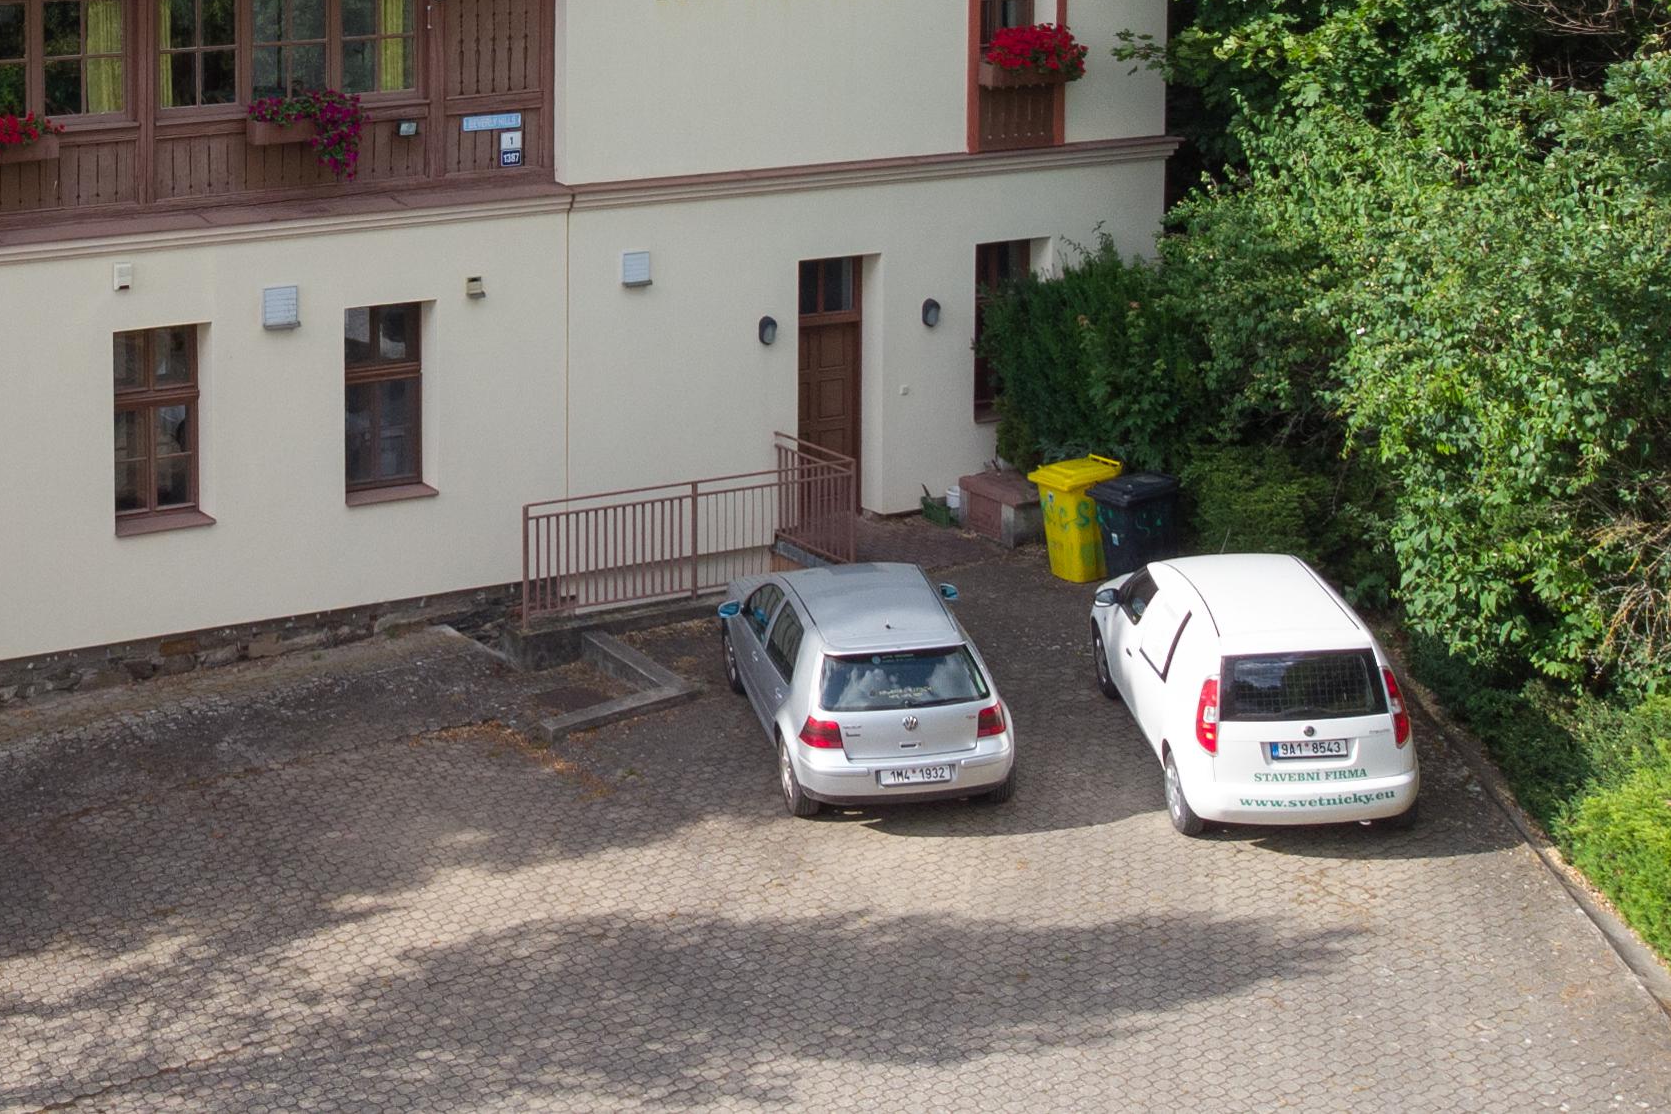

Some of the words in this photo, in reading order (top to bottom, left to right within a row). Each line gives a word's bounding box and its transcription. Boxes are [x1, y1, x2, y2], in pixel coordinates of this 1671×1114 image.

[1281, 743, 1303, 755] 9A1
[1312, 741, 1341, 754] 8543
[890, 771, 910, 782] 1M4
[919, 767, 945, 779] 1932
[1254, 769, 1321, 783] STAVEBNÍ
[1325, 768, 1368, 781] FIRMA
[1240, 790, 1396, 808] www.svetnicky.eu
